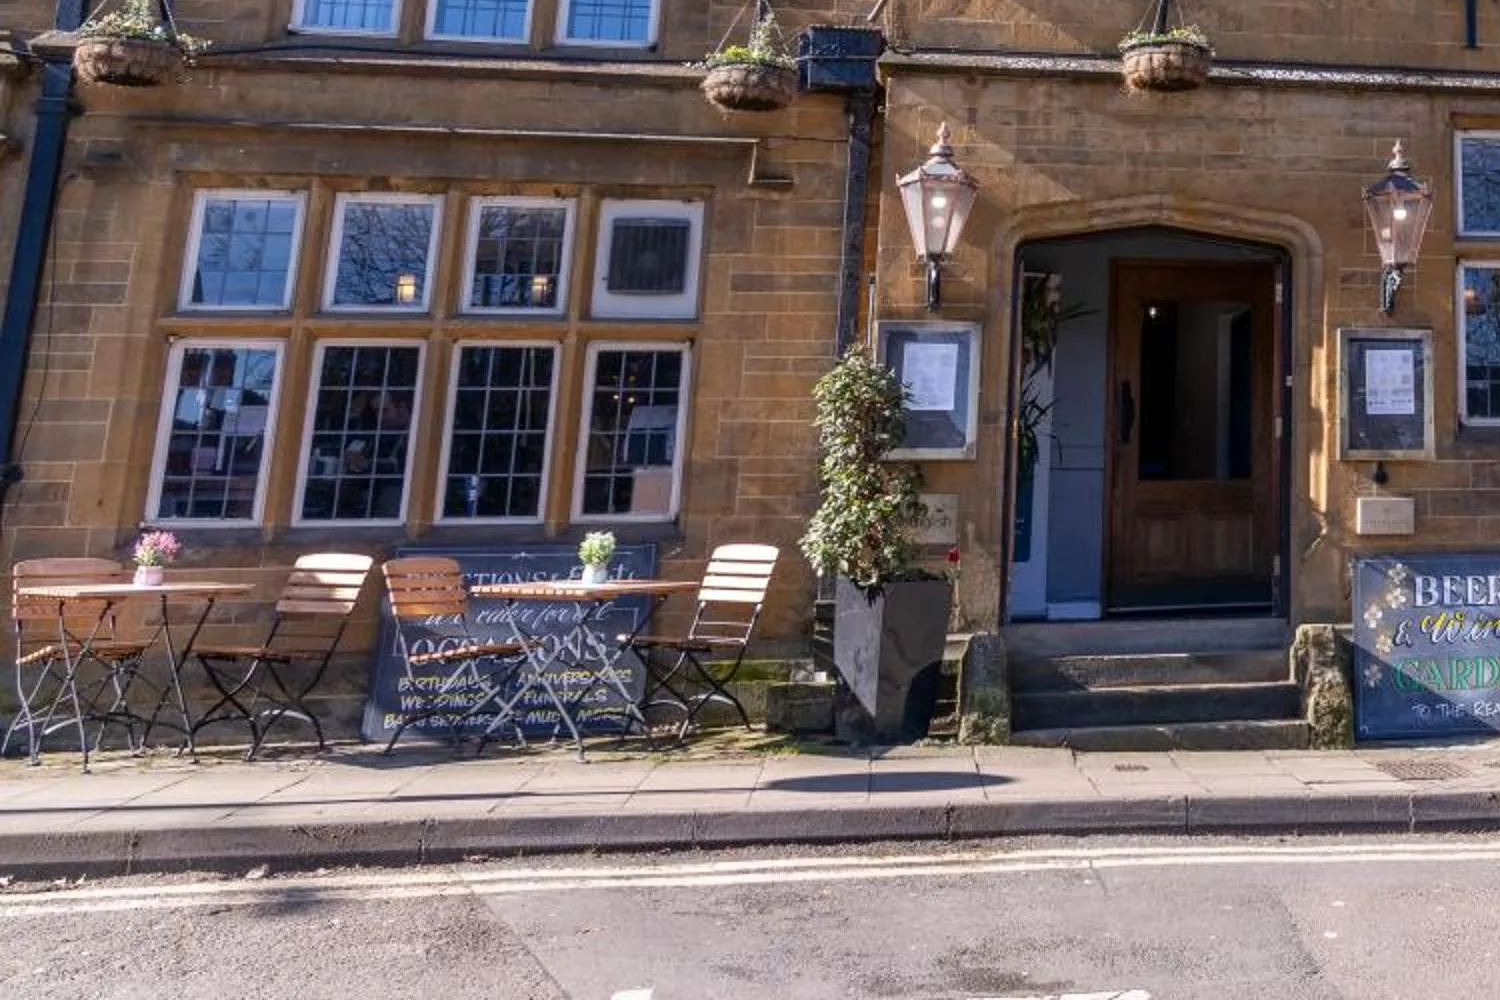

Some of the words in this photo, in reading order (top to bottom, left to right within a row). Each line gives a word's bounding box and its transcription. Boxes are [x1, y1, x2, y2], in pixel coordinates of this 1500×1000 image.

[1394, 618, 1413, 648] &
[1410, 703, 1431, 718] TO
[1434, 703, 1466, 718] THE
